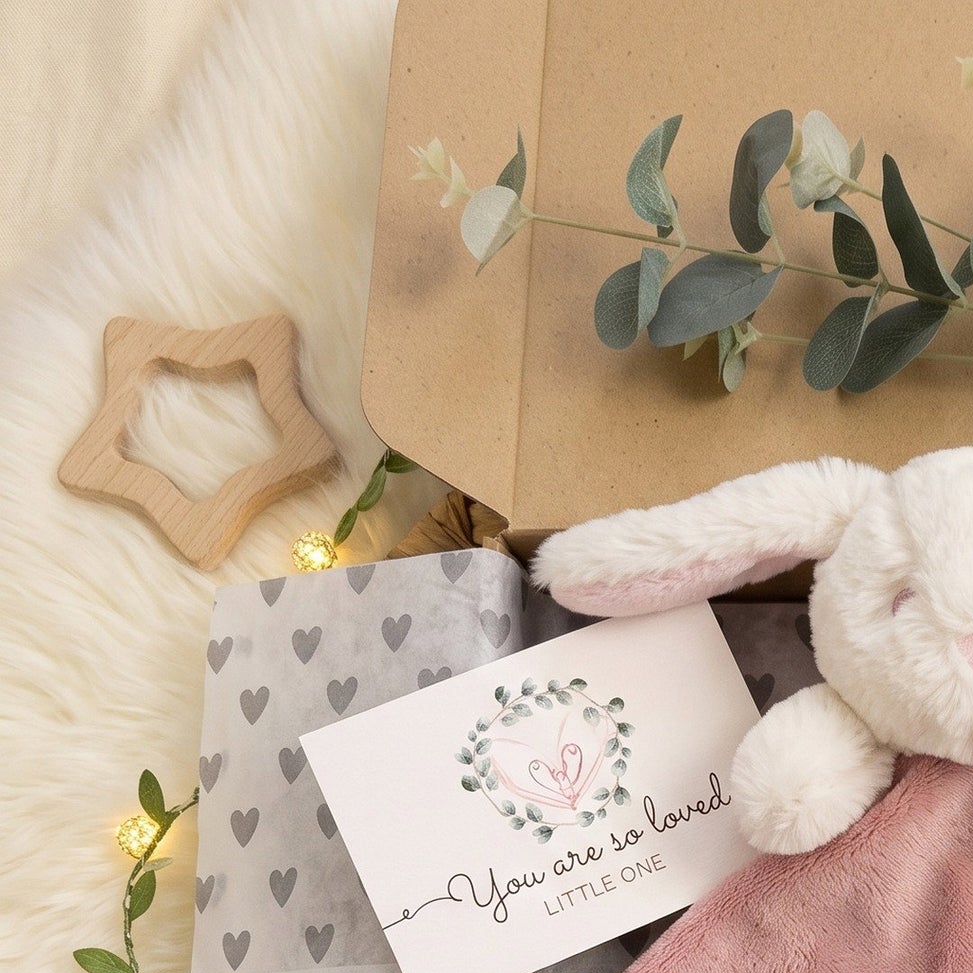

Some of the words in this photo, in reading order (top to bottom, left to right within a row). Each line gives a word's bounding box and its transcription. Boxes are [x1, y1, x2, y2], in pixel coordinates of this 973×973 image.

[447, 867, 546, 923] You
[552, 845, 604, 877] are
[611, 826, 644, 853] so
[643, 772, 732, 832] loved
[543, 874, 617, 916] LITTLE
[619, 852, 667, 886] ONE
